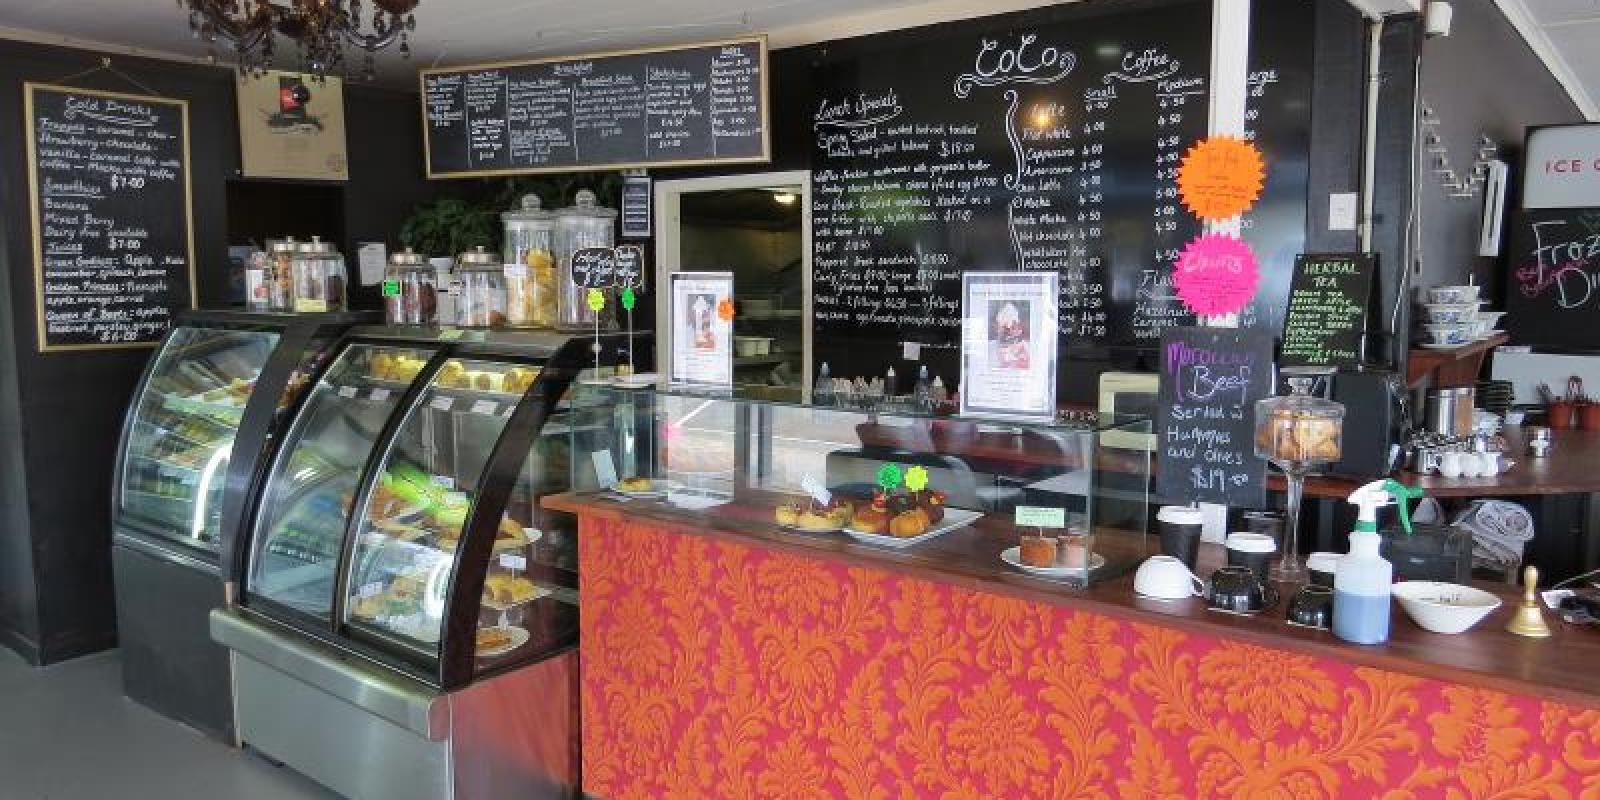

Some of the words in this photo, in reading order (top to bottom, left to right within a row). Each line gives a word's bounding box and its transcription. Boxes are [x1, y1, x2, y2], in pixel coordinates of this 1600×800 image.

[1248, 70, 1279, 86] arge
[1545, 158, 1583, 176] ICE
[1311, 276, 1338, 289] TEA
[1185, 365, 1251, 405] Beef
